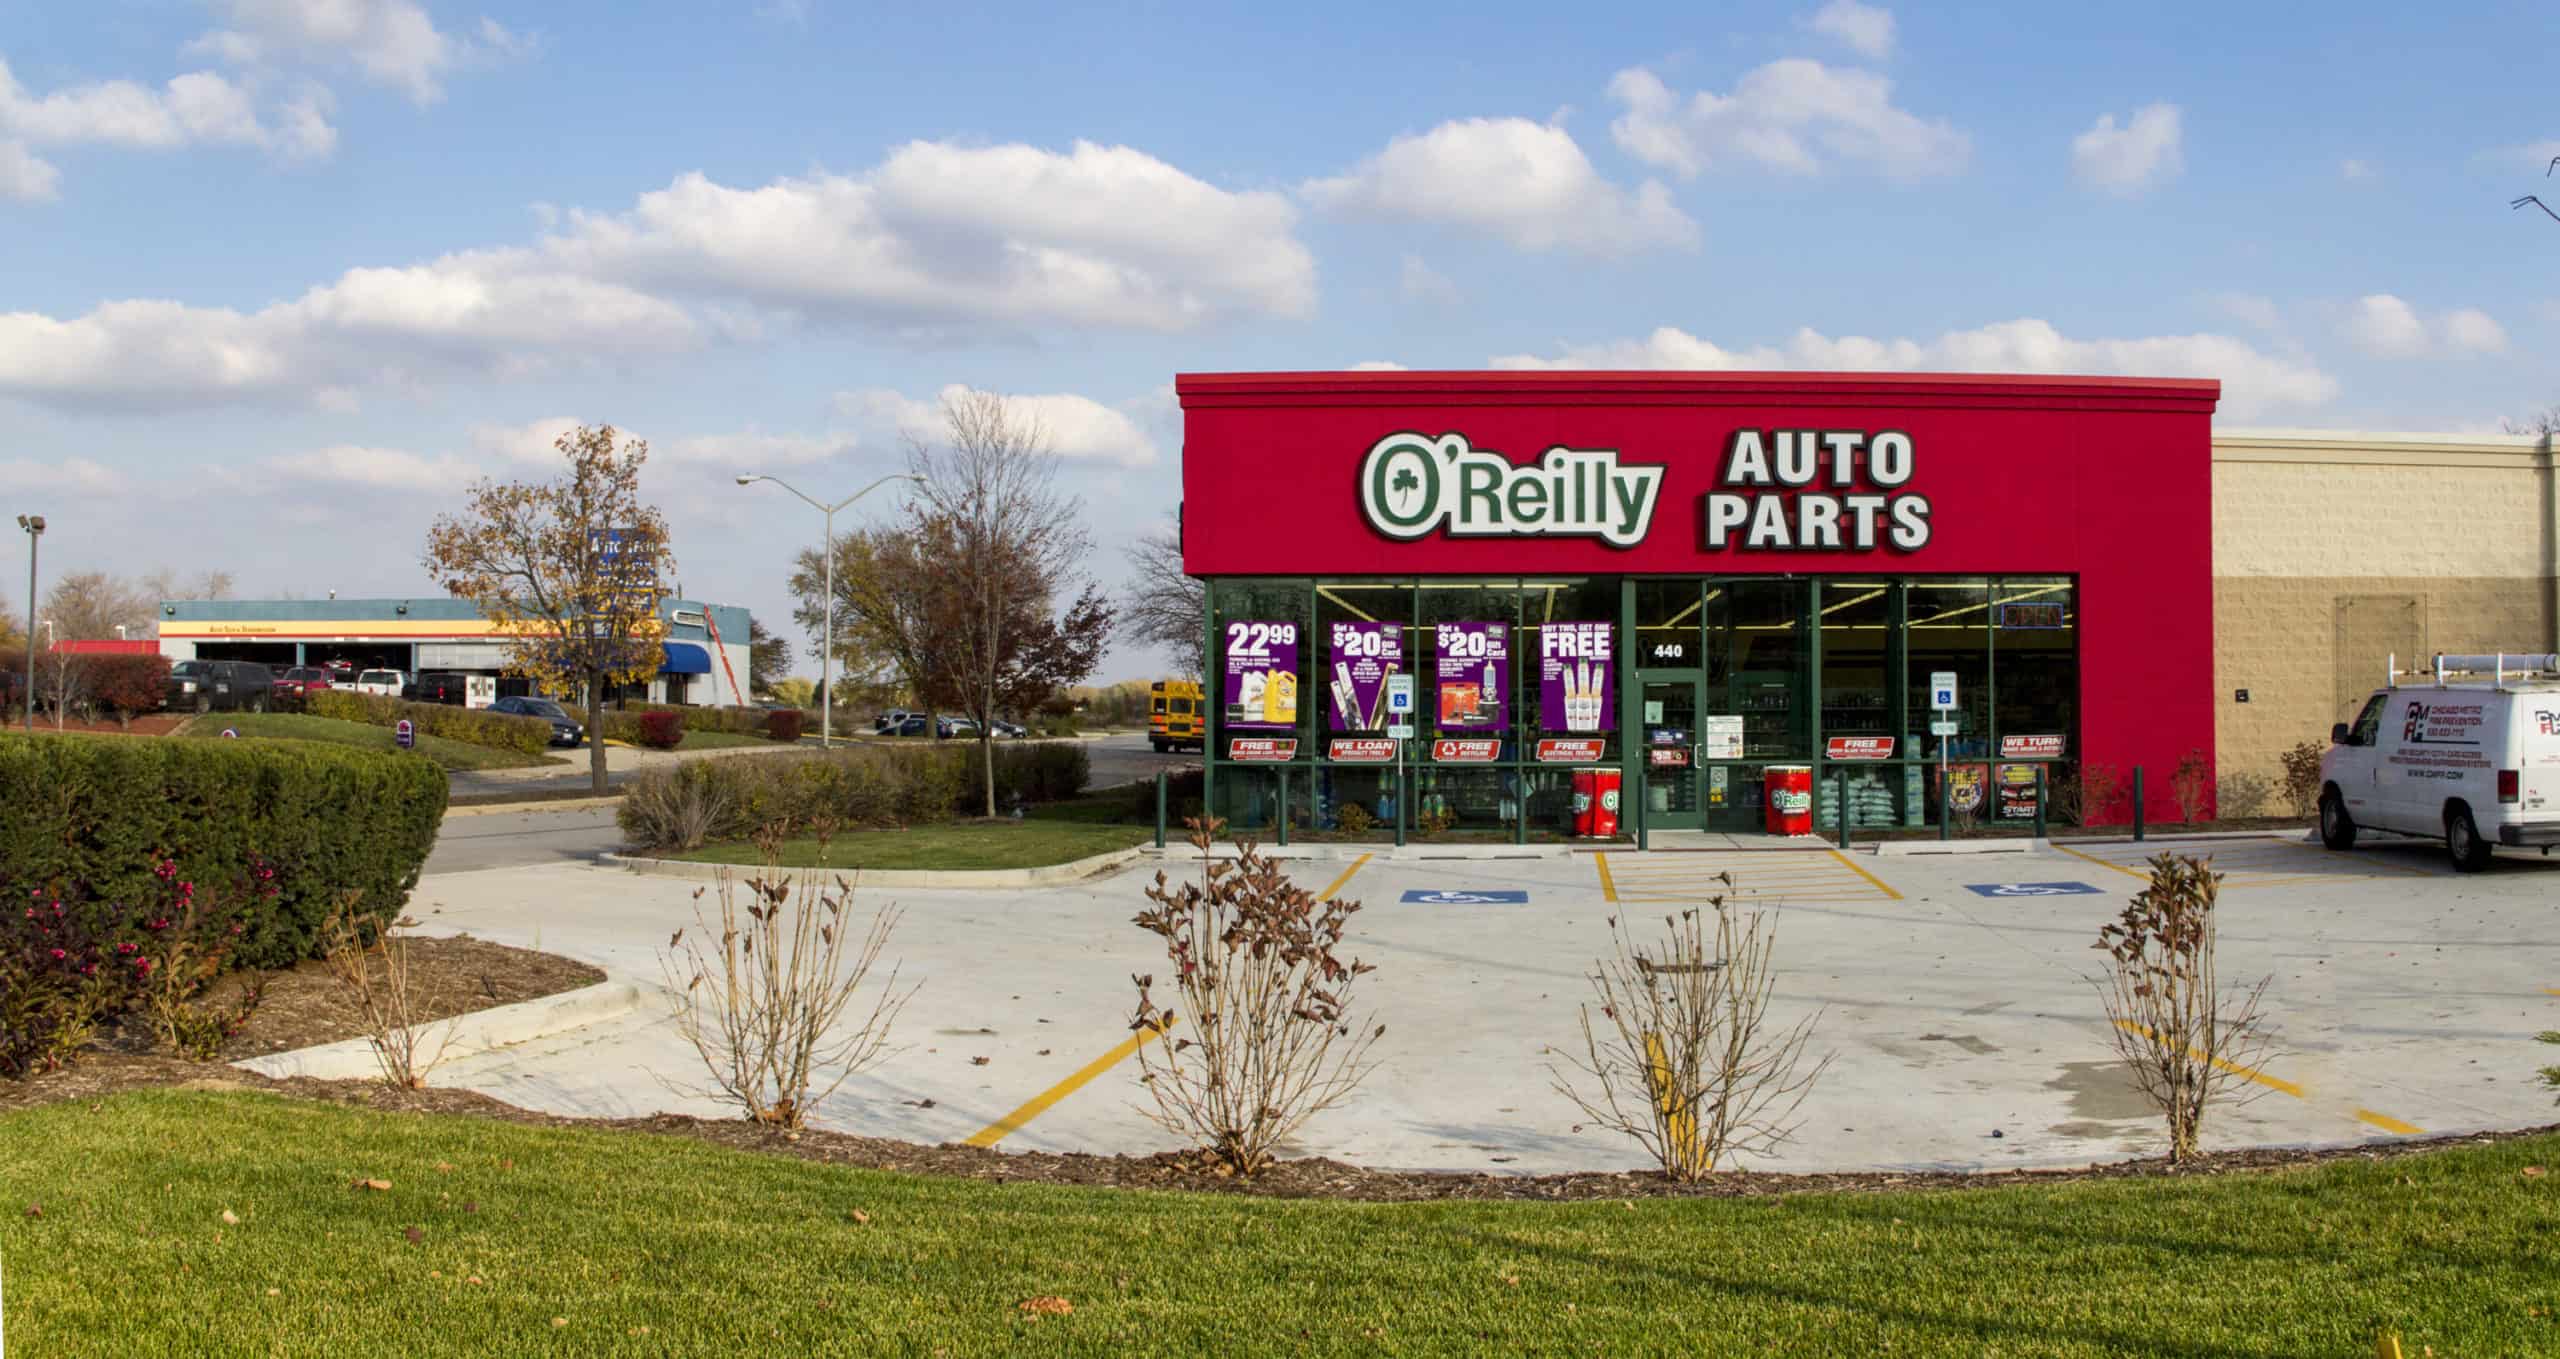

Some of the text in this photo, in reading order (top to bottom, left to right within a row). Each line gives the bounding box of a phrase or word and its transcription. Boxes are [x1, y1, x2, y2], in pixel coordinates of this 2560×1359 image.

[1725, 429, 1914, 485] AUTO
[1372, 442, 1652, 535] O'Reilly
[1705, 492, 1932, 549] PARTS
[2005, 606, 2060, 626] OPEN
[1333, 632, 1380, 657] $20
[1438, 632, 1485, 657] $20
[1542, 632, 1610, 657] FREE
[1654, 644, 1683, 658] 440
[1240, 742, 1272, 750] FREE
[1555, 742, 1588, 750] FREE
[1844, 740, 1877, 748] FREE
[2006, 737, 2062, 746] WE TURN
